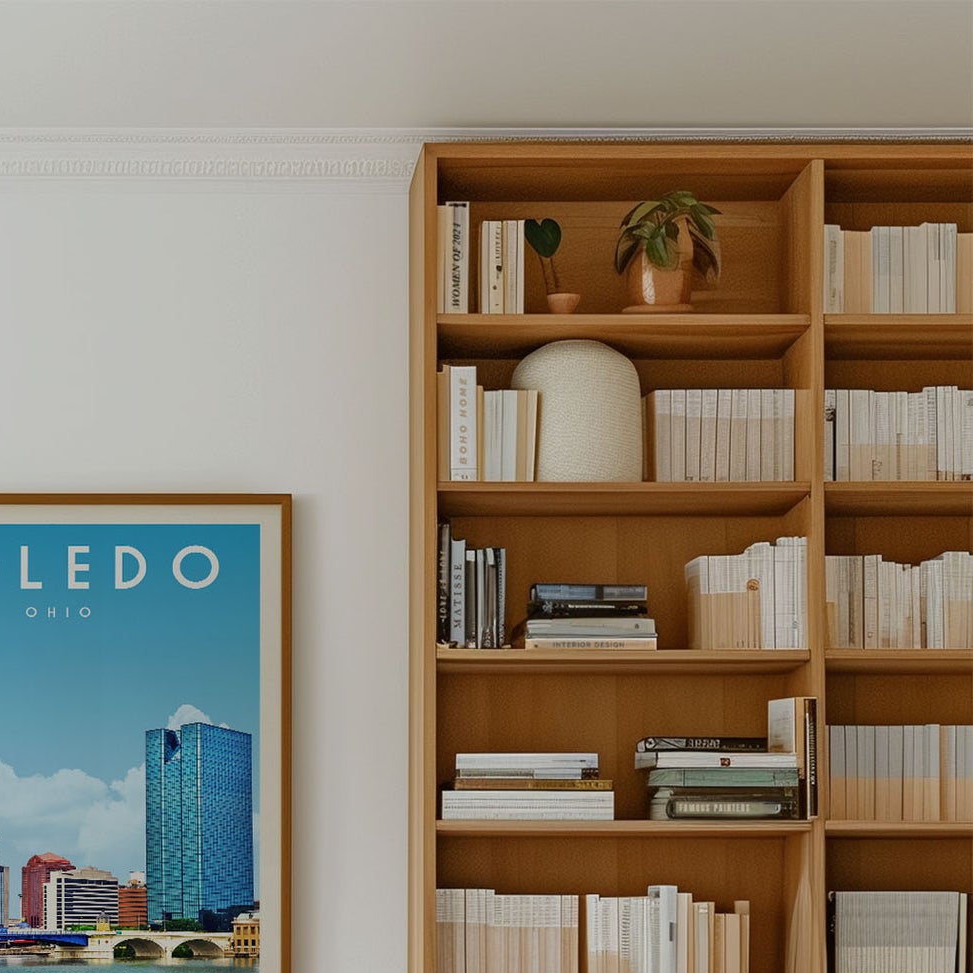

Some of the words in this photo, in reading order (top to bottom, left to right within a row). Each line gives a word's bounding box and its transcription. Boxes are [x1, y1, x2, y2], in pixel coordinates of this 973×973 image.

[452, 246, 461, 262] OF
[452, 264, 461, 307] WOMEN
[459, 425, 468, 465] BOHO
[453, 563, 462, 629] MATISSE
[25, 606, 92, 619] OHIO
[552, 641, 592, 649] INTERIOR
[594, 641, 625, 649] DESIGN
